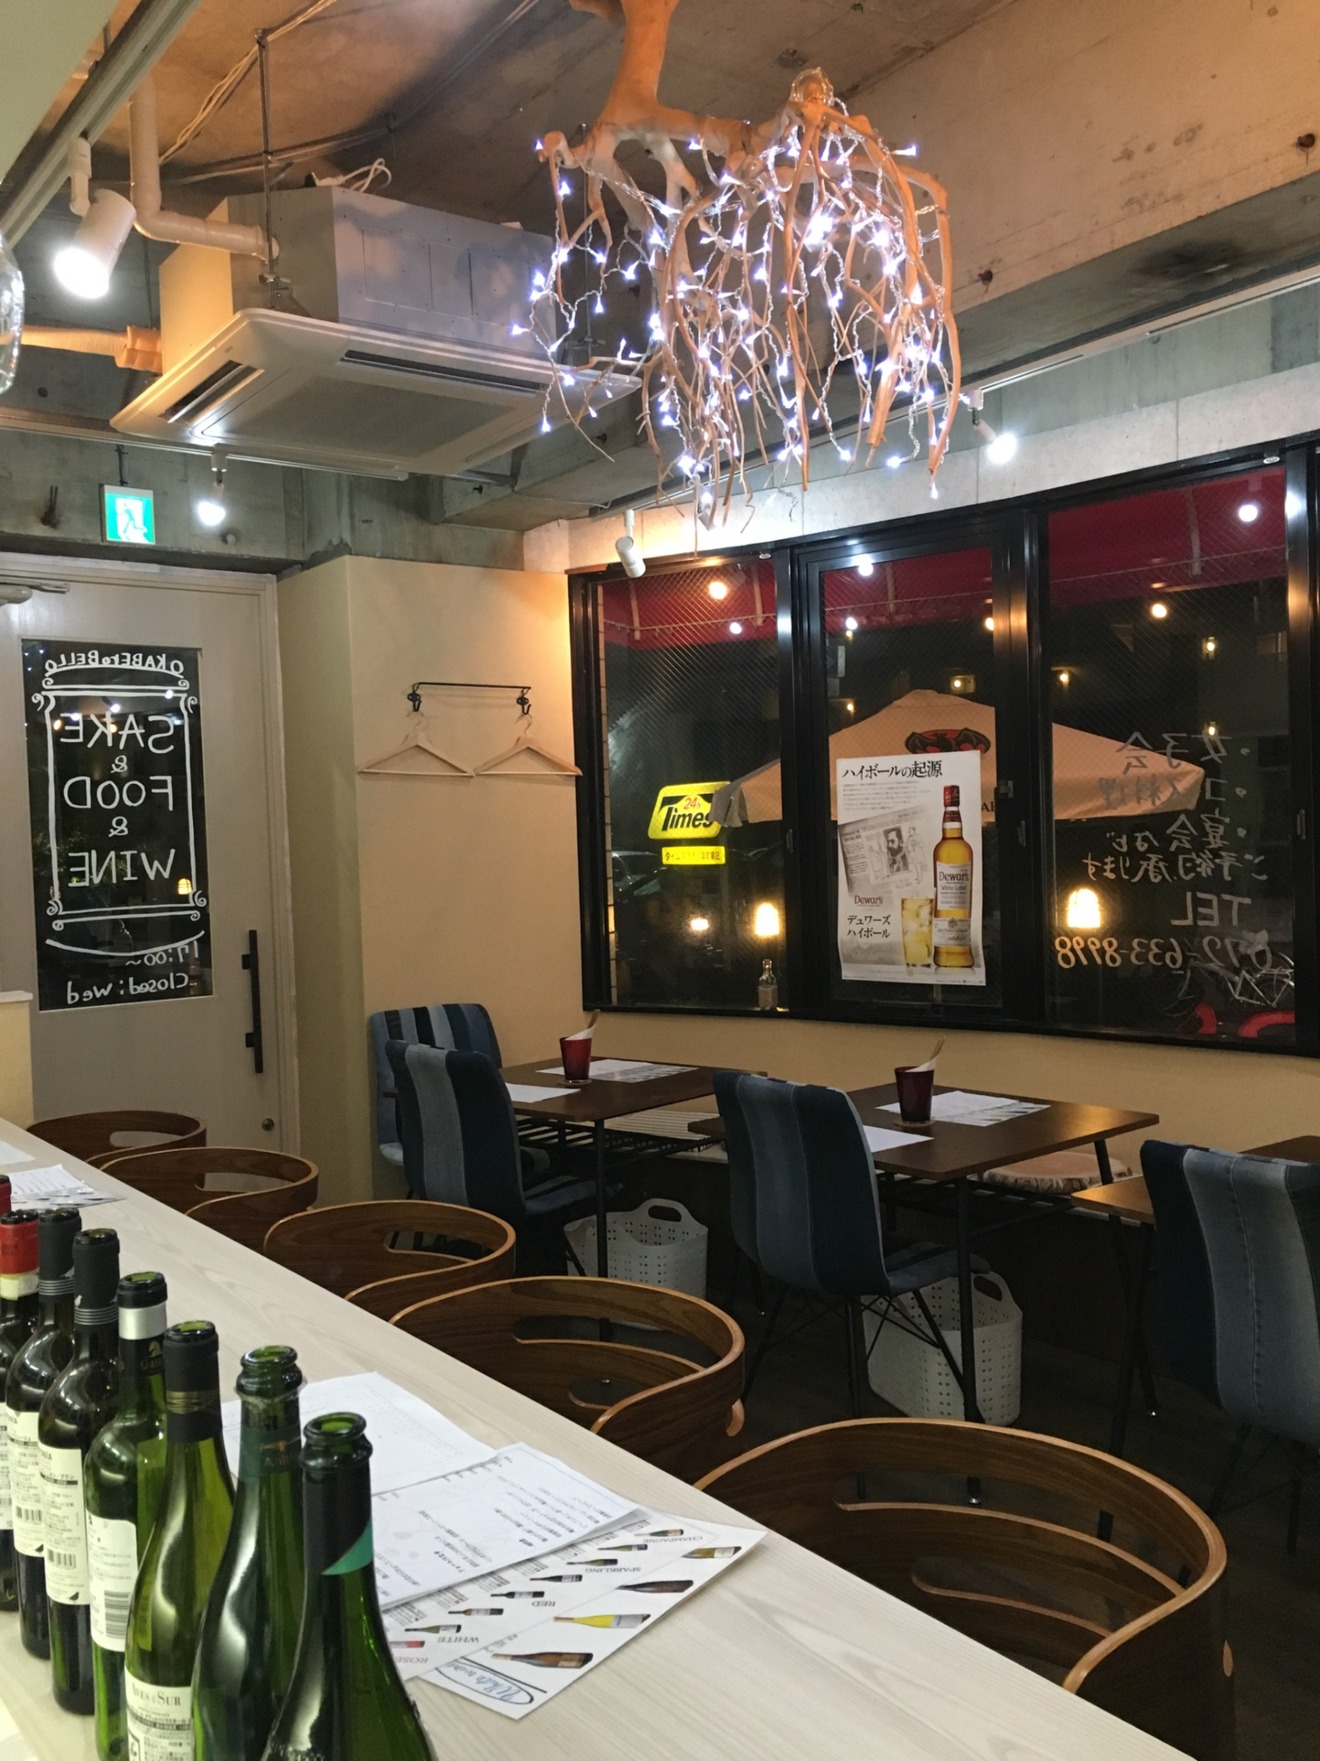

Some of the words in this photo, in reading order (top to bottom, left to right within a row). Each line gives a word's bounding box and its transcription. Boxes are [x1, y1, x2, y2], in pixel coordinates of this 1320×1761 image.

[842, 760, 943, 780] ハイボールの起源
[854, 895, 883, 905] Dewar's
[847, 914, 891, 926] デュワーズ
[847, 927, 891, 939] ハイボール
[437, 1636, 480, 1644] WHITE
